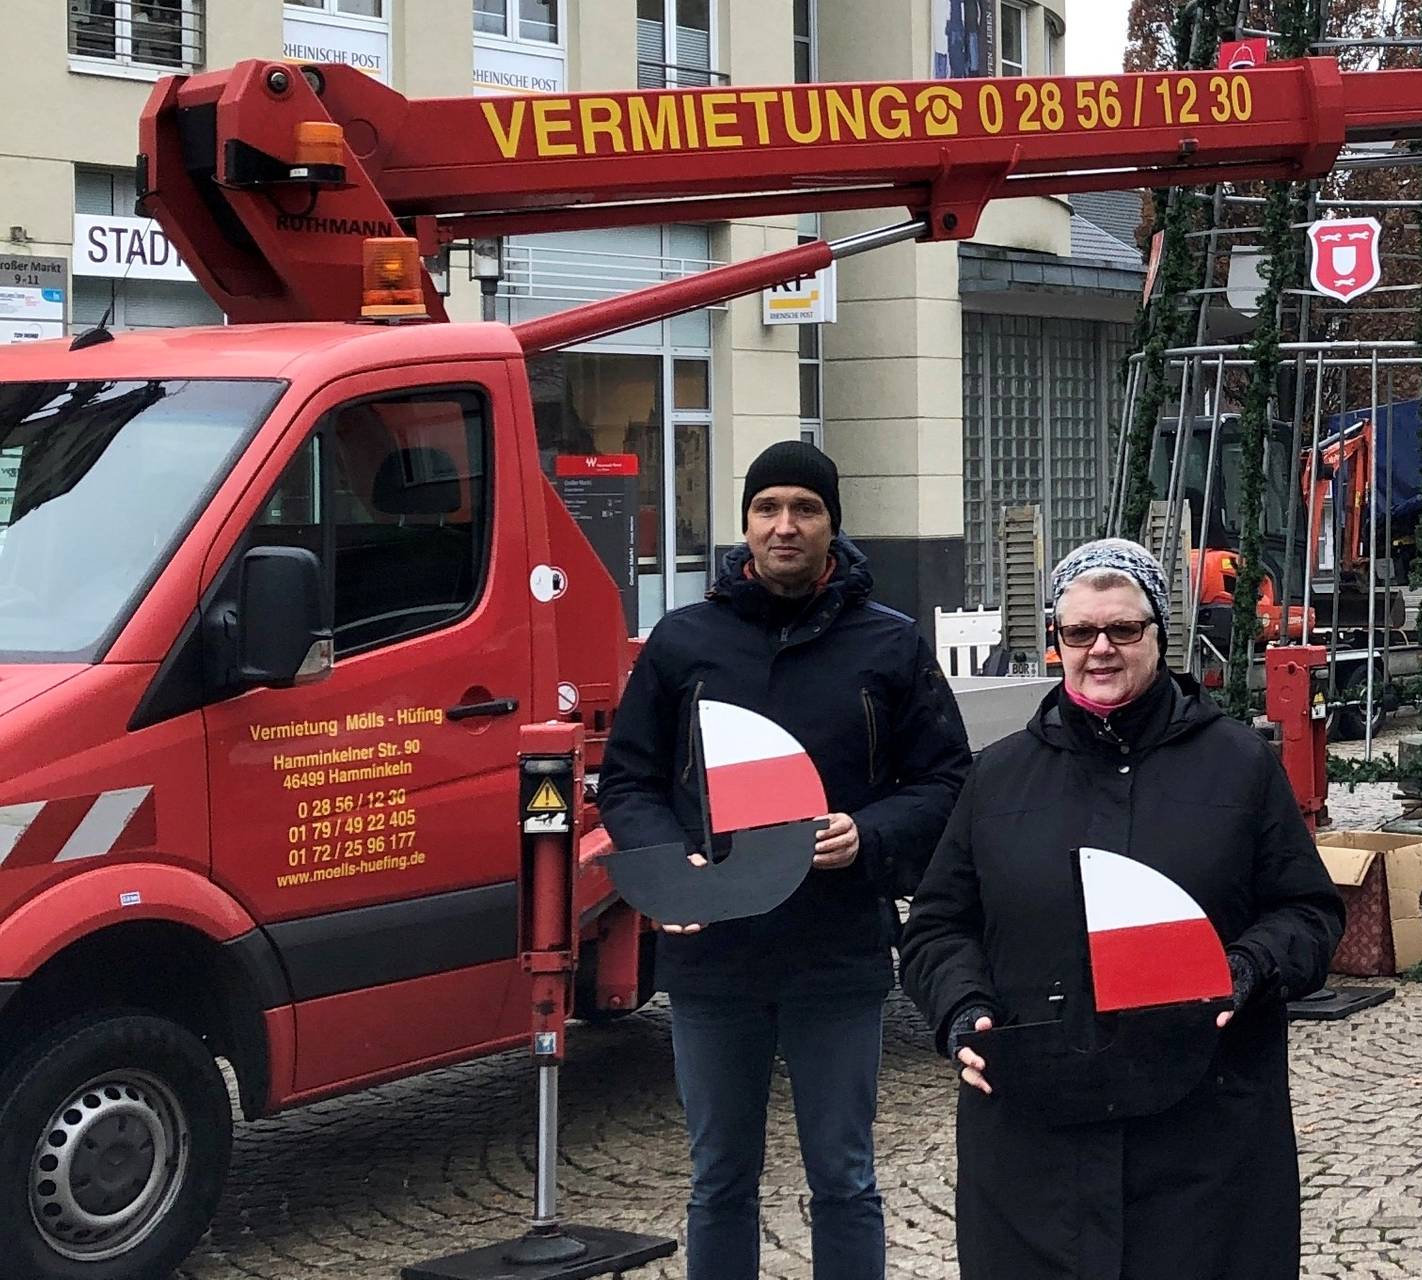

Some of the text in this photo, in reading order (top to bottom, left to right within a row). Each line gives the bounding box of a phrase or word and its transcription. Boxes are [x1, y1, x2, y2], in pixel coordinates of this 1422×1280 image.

[351, 52, 381, 69] POST
[531, 77, 557, 92] POST
[480, 75, 1252, 159] VERMIETUNG 0 28 56 / 12 30
[0, 260, 61, 273] roßer Markt
[250, 720, 338, 741] Vermietung
[346, 712, 384, 731] Mölls
[397, 707, 443, 726] Hüfing
[273, 739, 421, 771] Hamminkelner Str. 90
[283, 760, 412, 790] 46499 Hamminkeln
[298, 788, 406, 819] 0 28 56 / 12 30
[289, 809, 416, 843] 01 79 / 49 22 405
[289, 831, 416, 867] 01 72 / 25 96 177
[277, 851, 426, 888] www.moells-huefing.de
